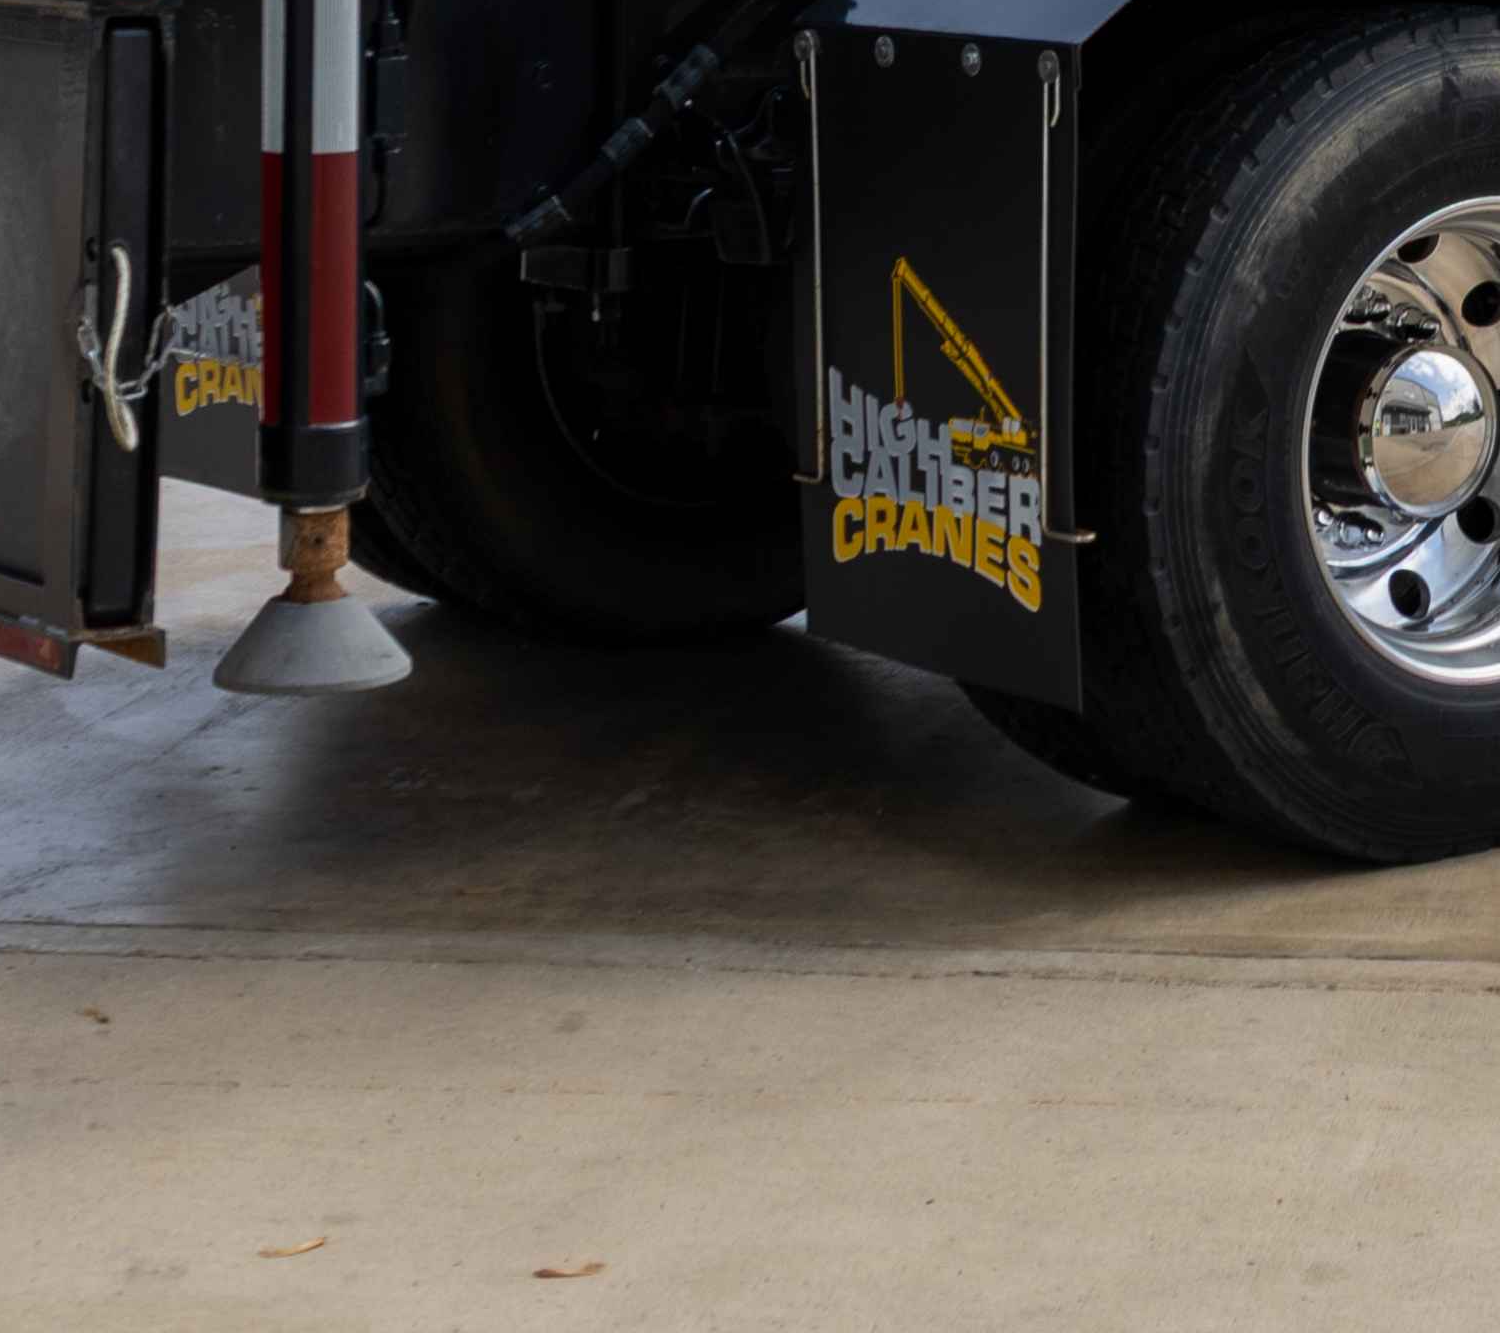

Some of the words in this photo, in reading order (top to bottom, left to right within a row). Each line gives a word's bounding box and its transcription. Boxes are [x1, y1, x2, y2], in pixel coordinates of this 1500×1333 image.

[175, 358, 265, 422] CRAN
[828, 365, 953, 471] HIGH
[831, 432, 1043, 547] CALIBER
[833, 494, 1042, 613] CRANES
